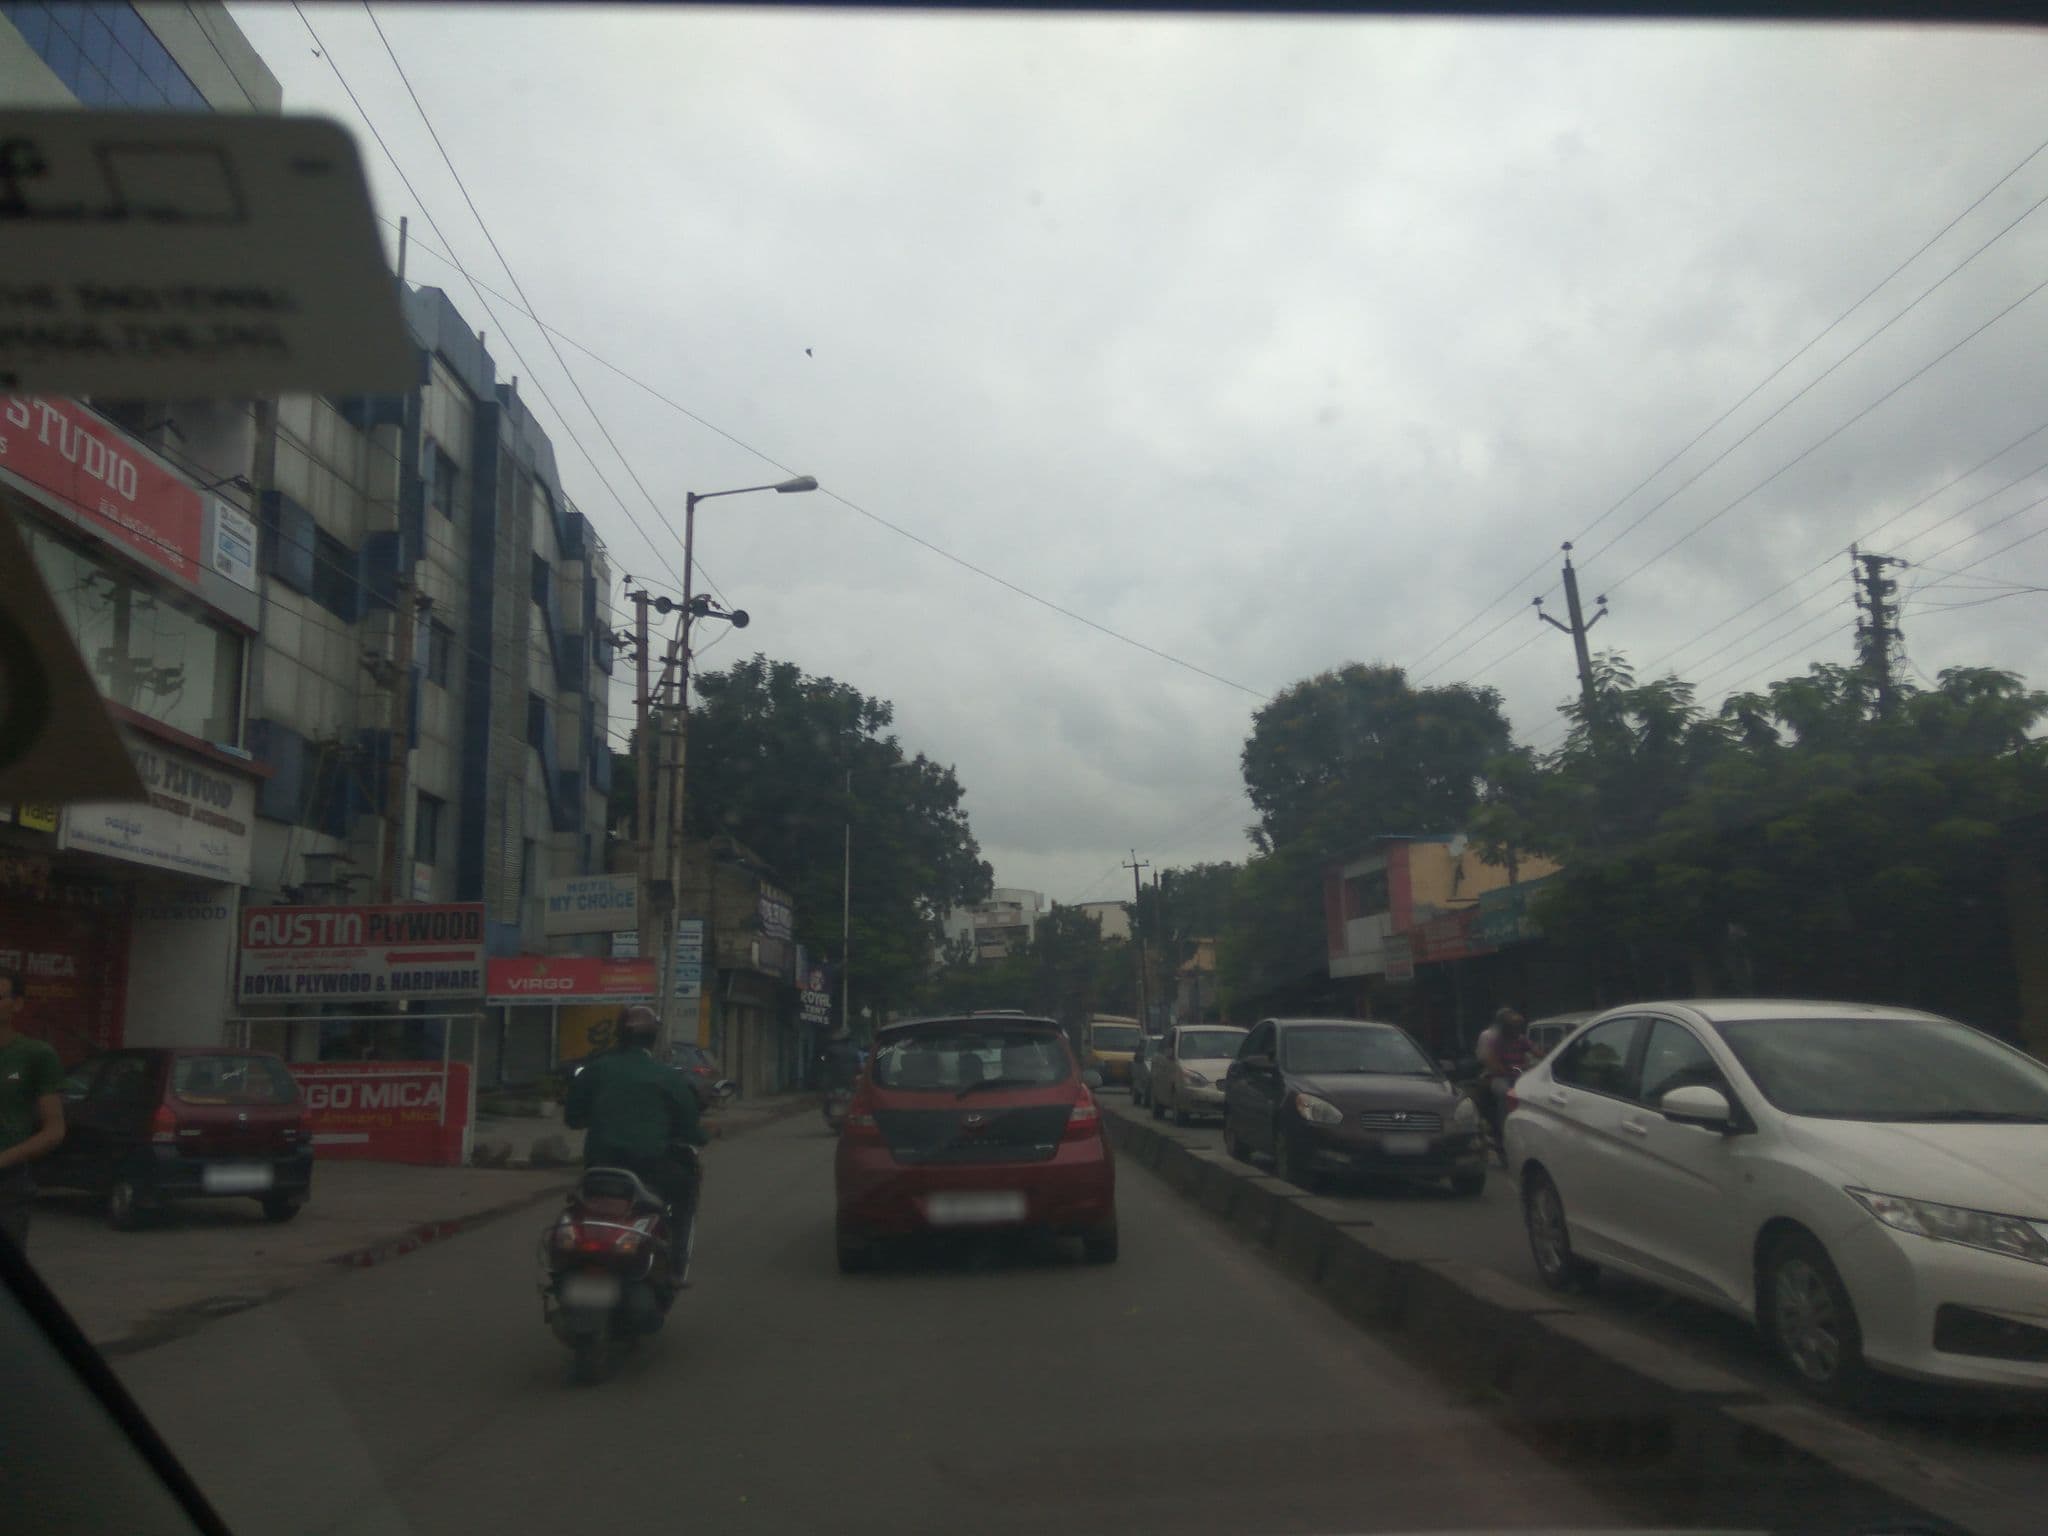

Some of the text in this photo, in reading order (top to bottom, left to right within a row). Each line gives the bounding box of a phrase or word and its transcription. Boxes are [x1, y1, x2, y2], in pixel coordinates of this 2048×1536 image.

[6, 394, 138, 502] STUDIO
[549, 891, 635, 912] MY CHOICE
[251, 911, 480, 946] AUSTIN PLYWOOD
[245, 975, 293, 994] ROYAL
[295, 973, 371, 993] PLYWOOD
[390, 969, 480, 991] HARDWARE
[507, 977, 575, 991] VIRGO
[359, 1081, 444, 1109] MICA
